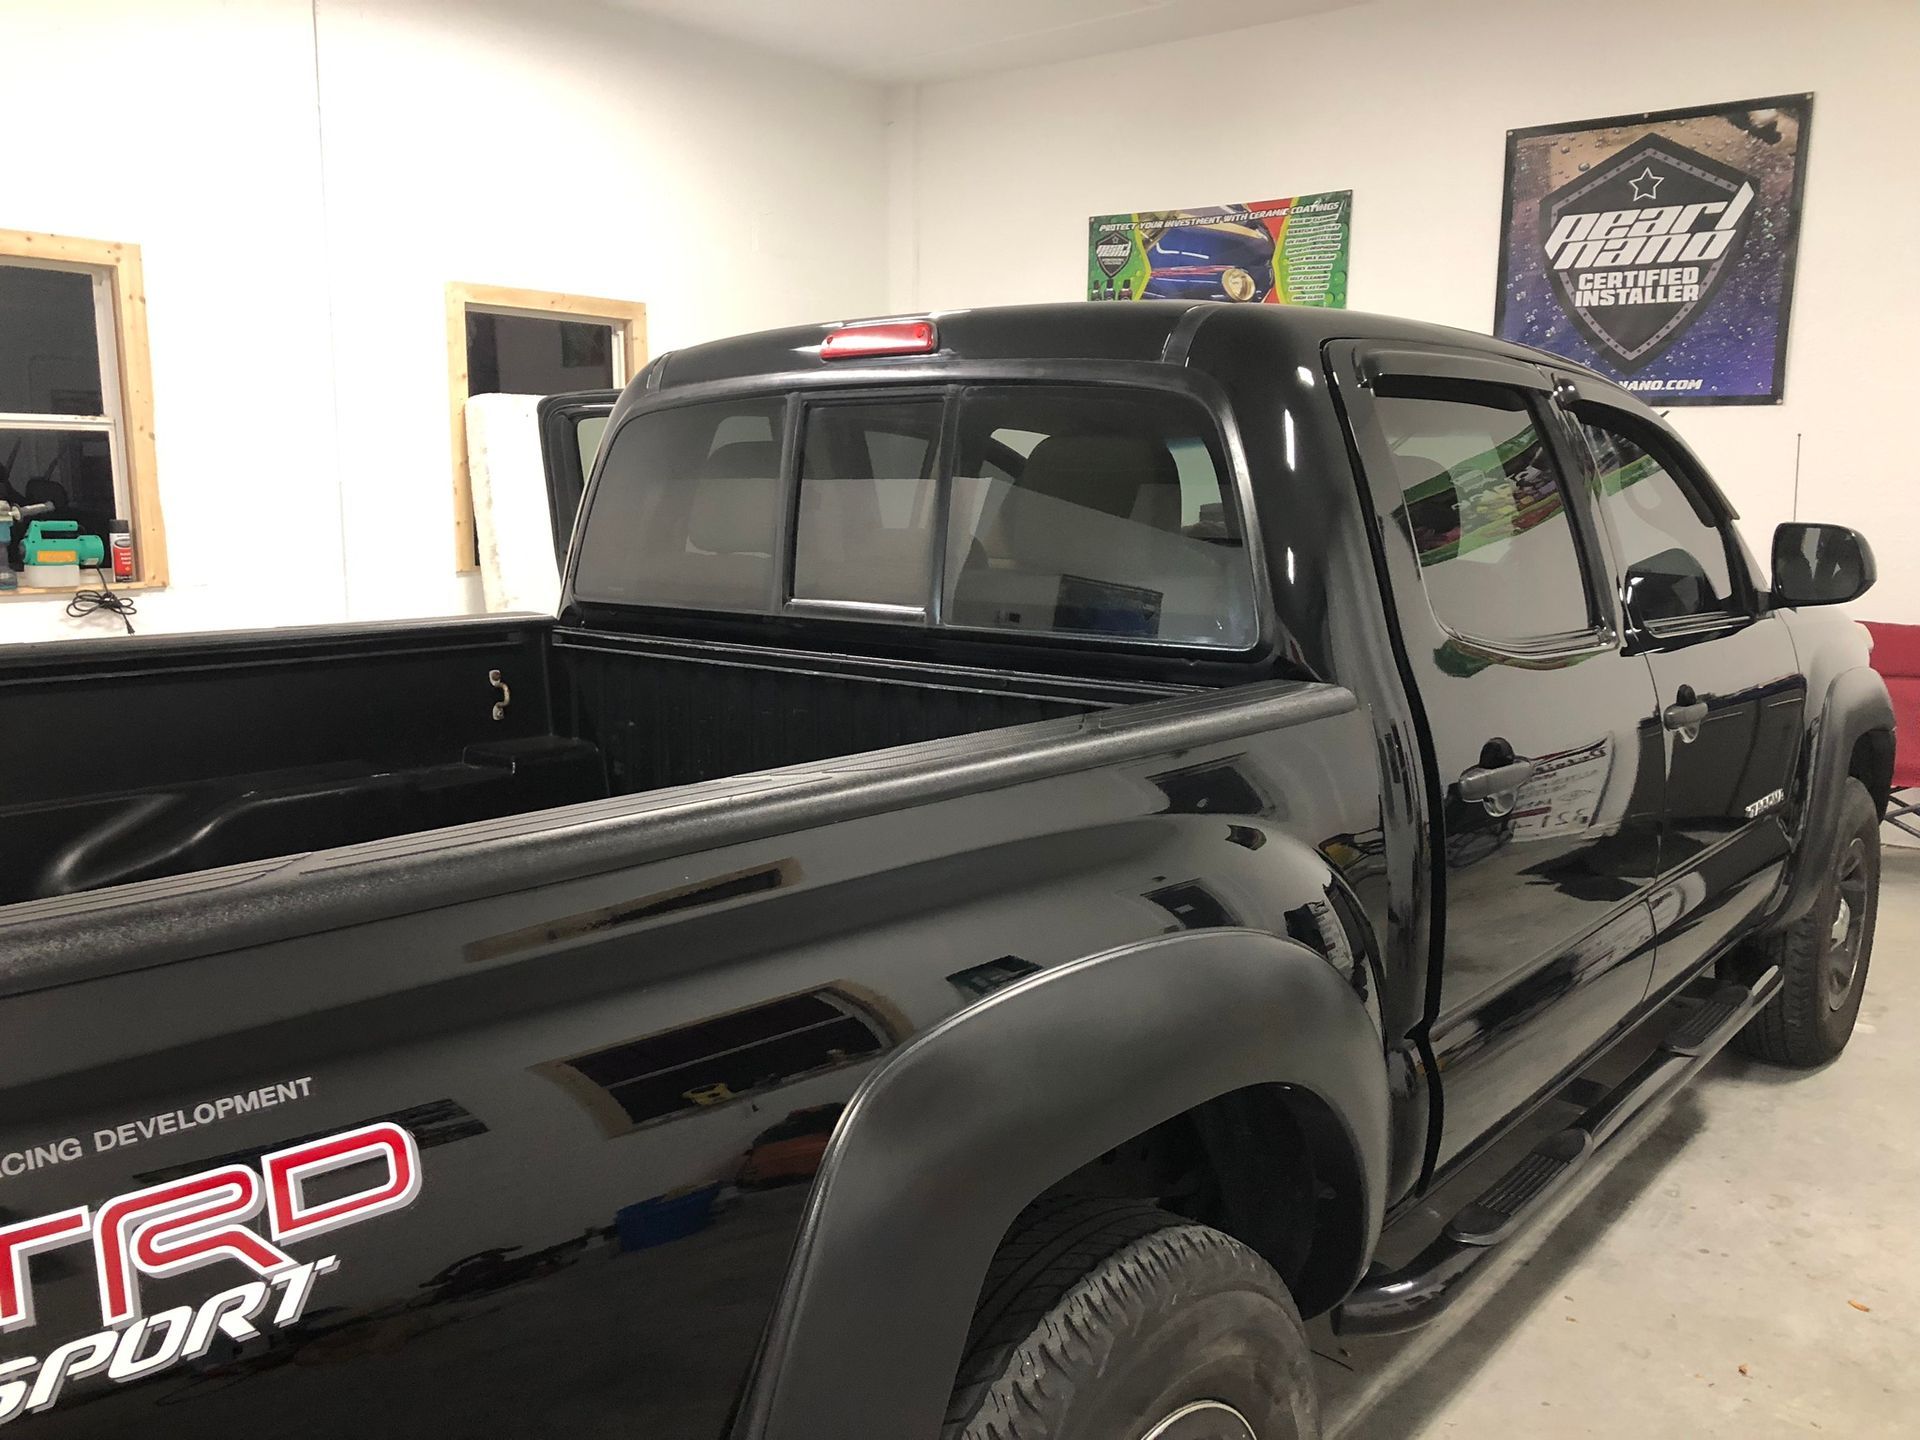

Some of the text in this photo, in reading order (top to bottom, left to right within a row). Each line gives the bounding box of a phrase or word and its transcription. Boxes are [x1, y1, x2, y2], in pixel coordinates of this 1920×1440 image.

[1099, 201, 1341, 232] PROTECT YOUR INVESTMENT WITH CERAMIC COATINGS
[1553, 229, 1737, 270] nano
[1574, 284, 1700, 307] INSTALLER
[1578, 267, 1700, 291] CERTIFIED
[0, 1076, 313, 1178] CING DEVELOPMENT
[0, 1121, 423, 1334] TRD
[0, 1254, 342, 1425] SPORT
